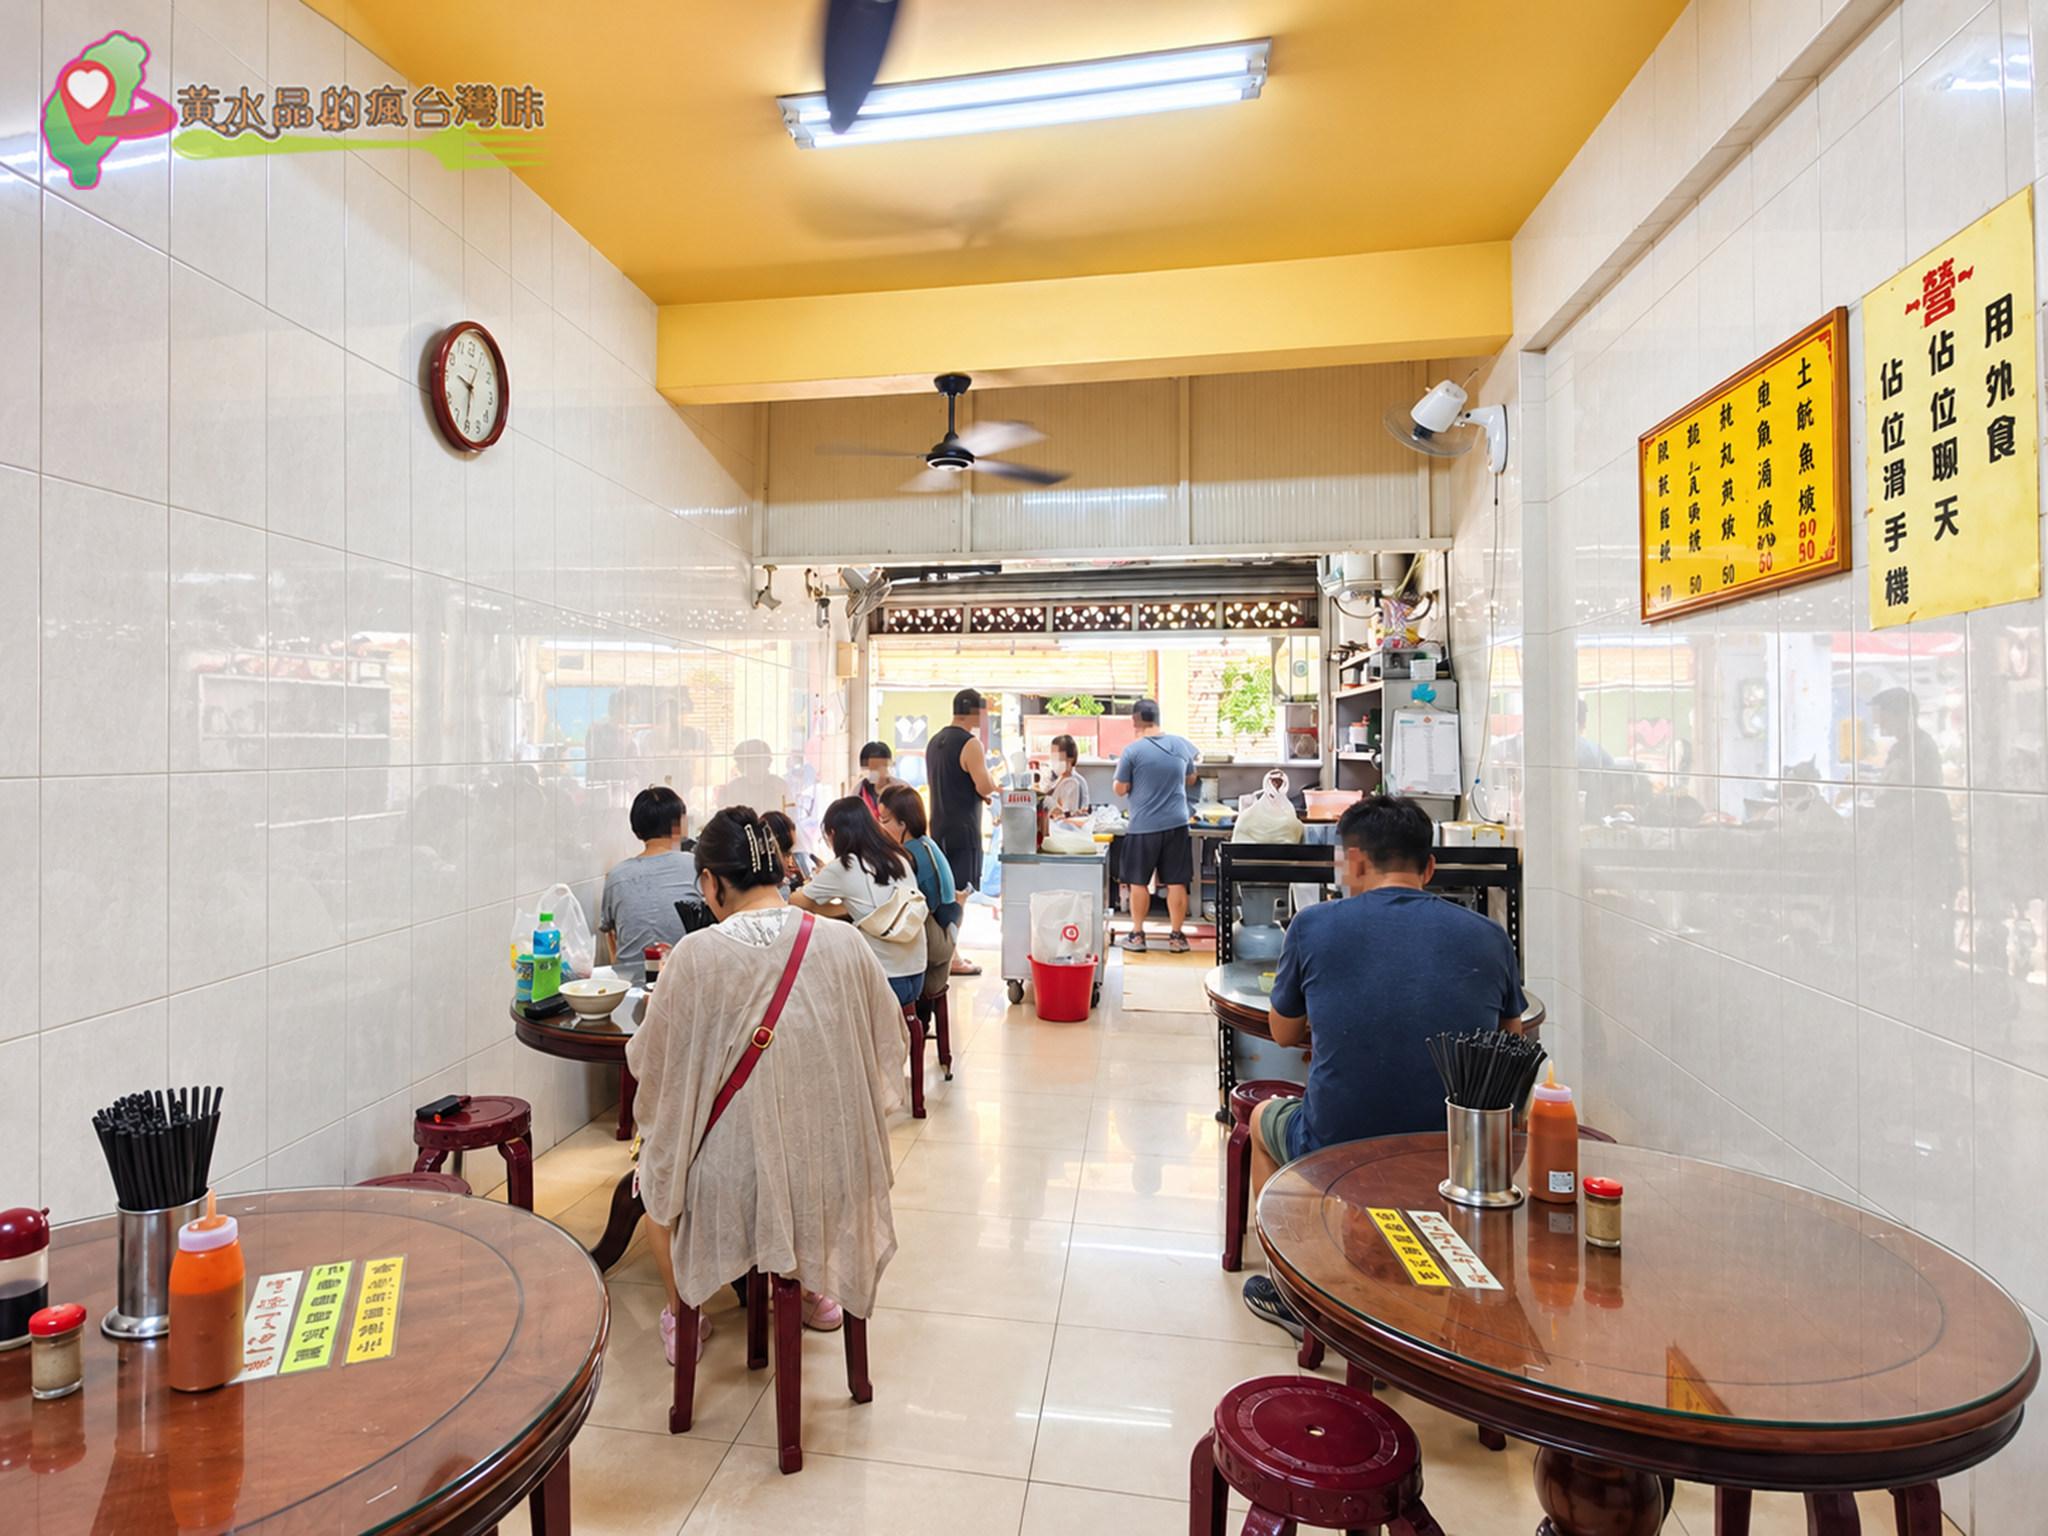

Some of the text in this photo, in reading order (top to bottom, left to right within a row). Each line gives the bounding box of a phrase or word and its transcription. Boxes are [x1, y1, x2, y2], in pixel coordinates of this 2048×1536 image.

[1880, 358, 1910, 607] 佔位滑手機
[1928, 329, 1960, 541] 佔位聊天
